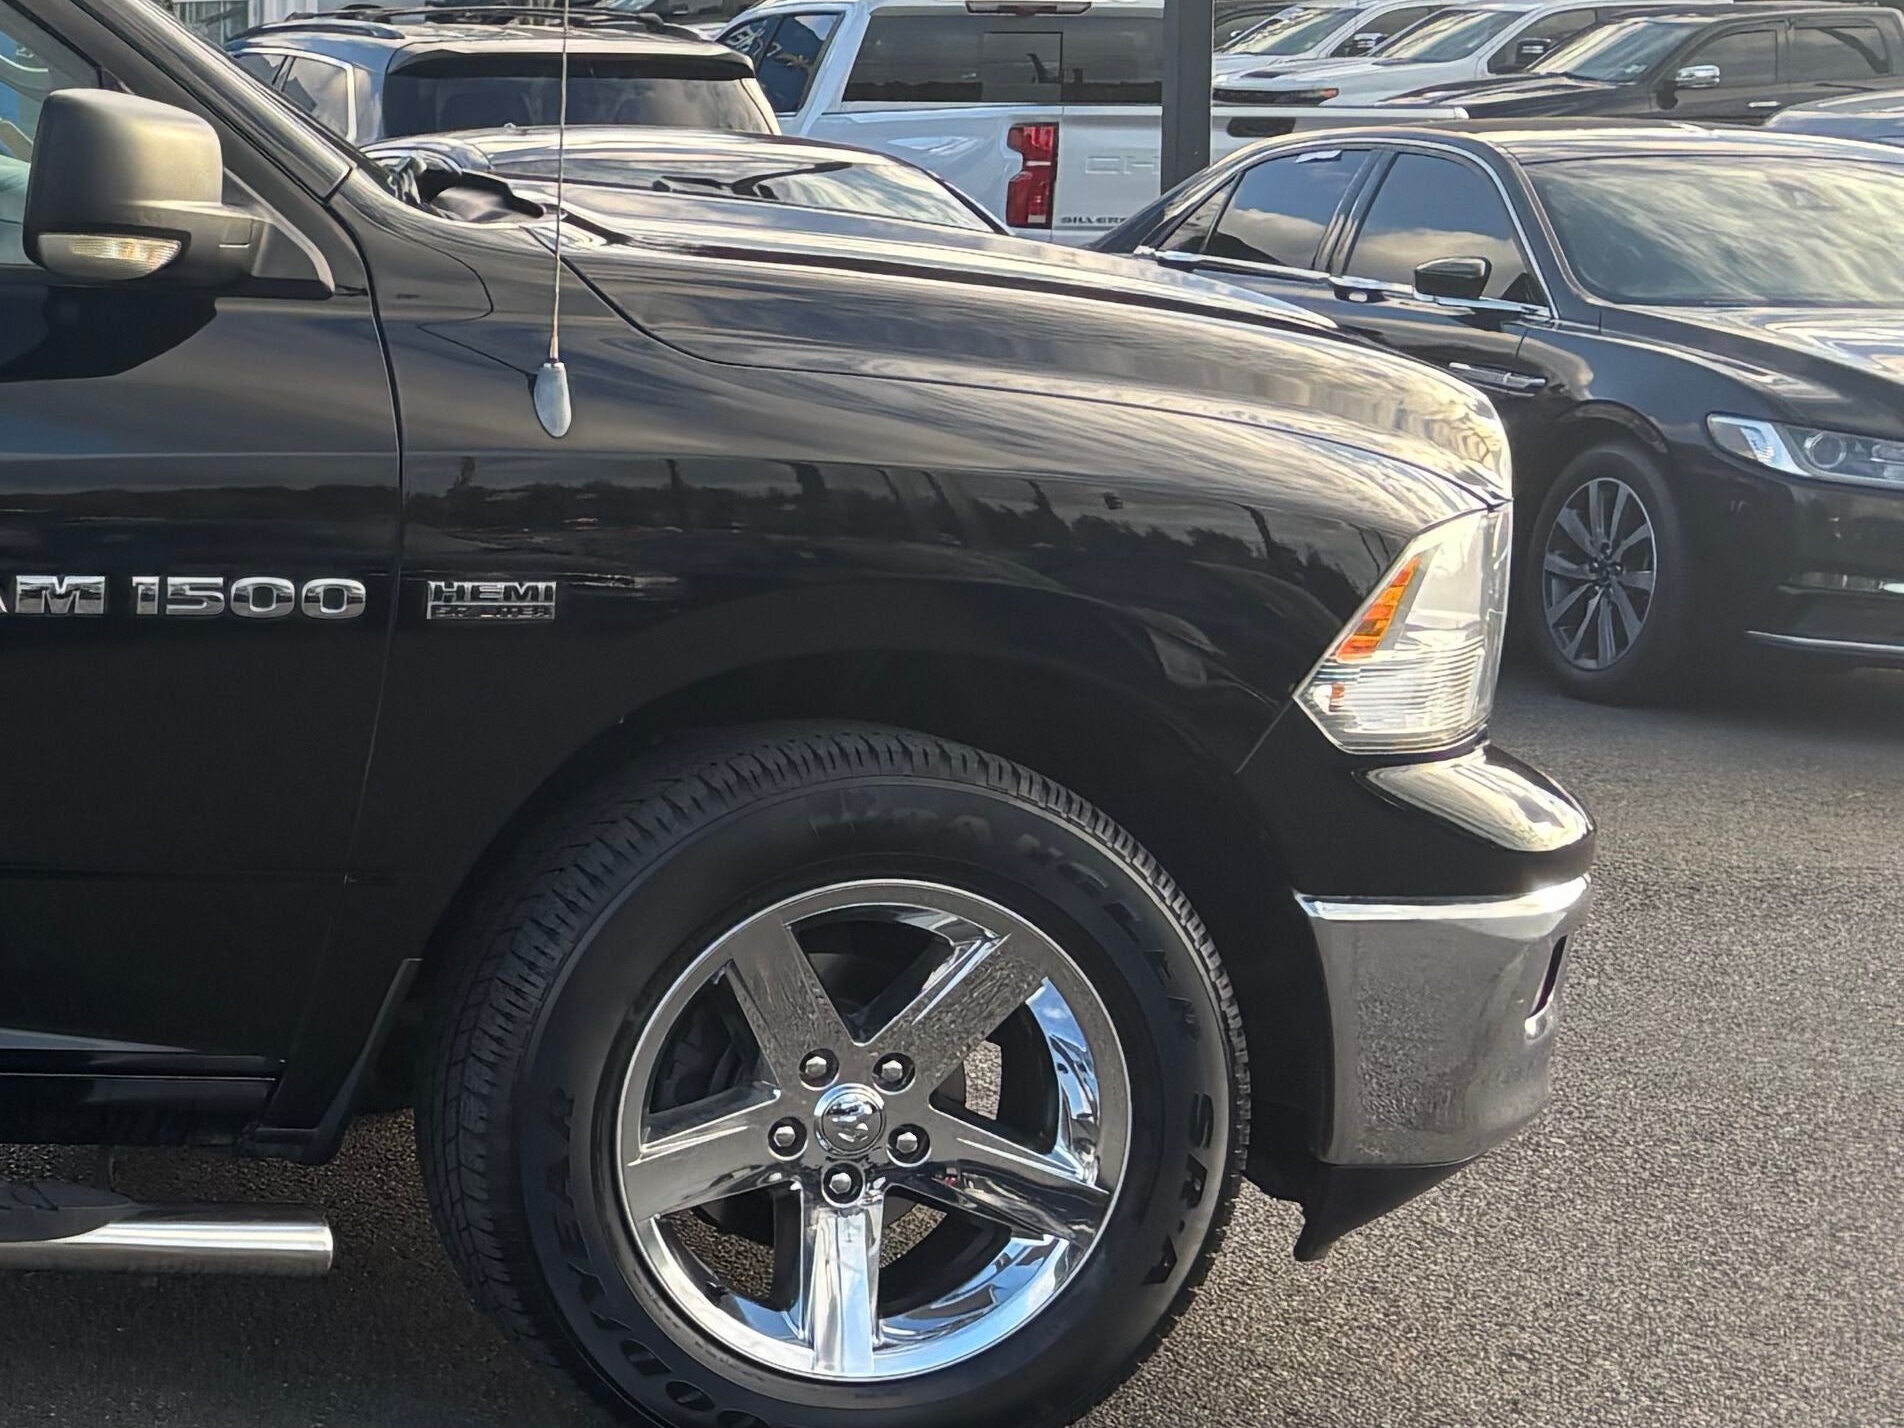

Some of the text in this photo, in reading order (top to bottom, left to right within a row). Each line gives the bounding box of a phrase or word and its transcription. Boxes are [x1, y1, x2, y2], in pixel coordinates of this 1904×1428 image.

[1060, 216, 1128, 225] SILVER
[131, 575, 367, 619] 1500
[430, 581, 555, 604] HEMI
